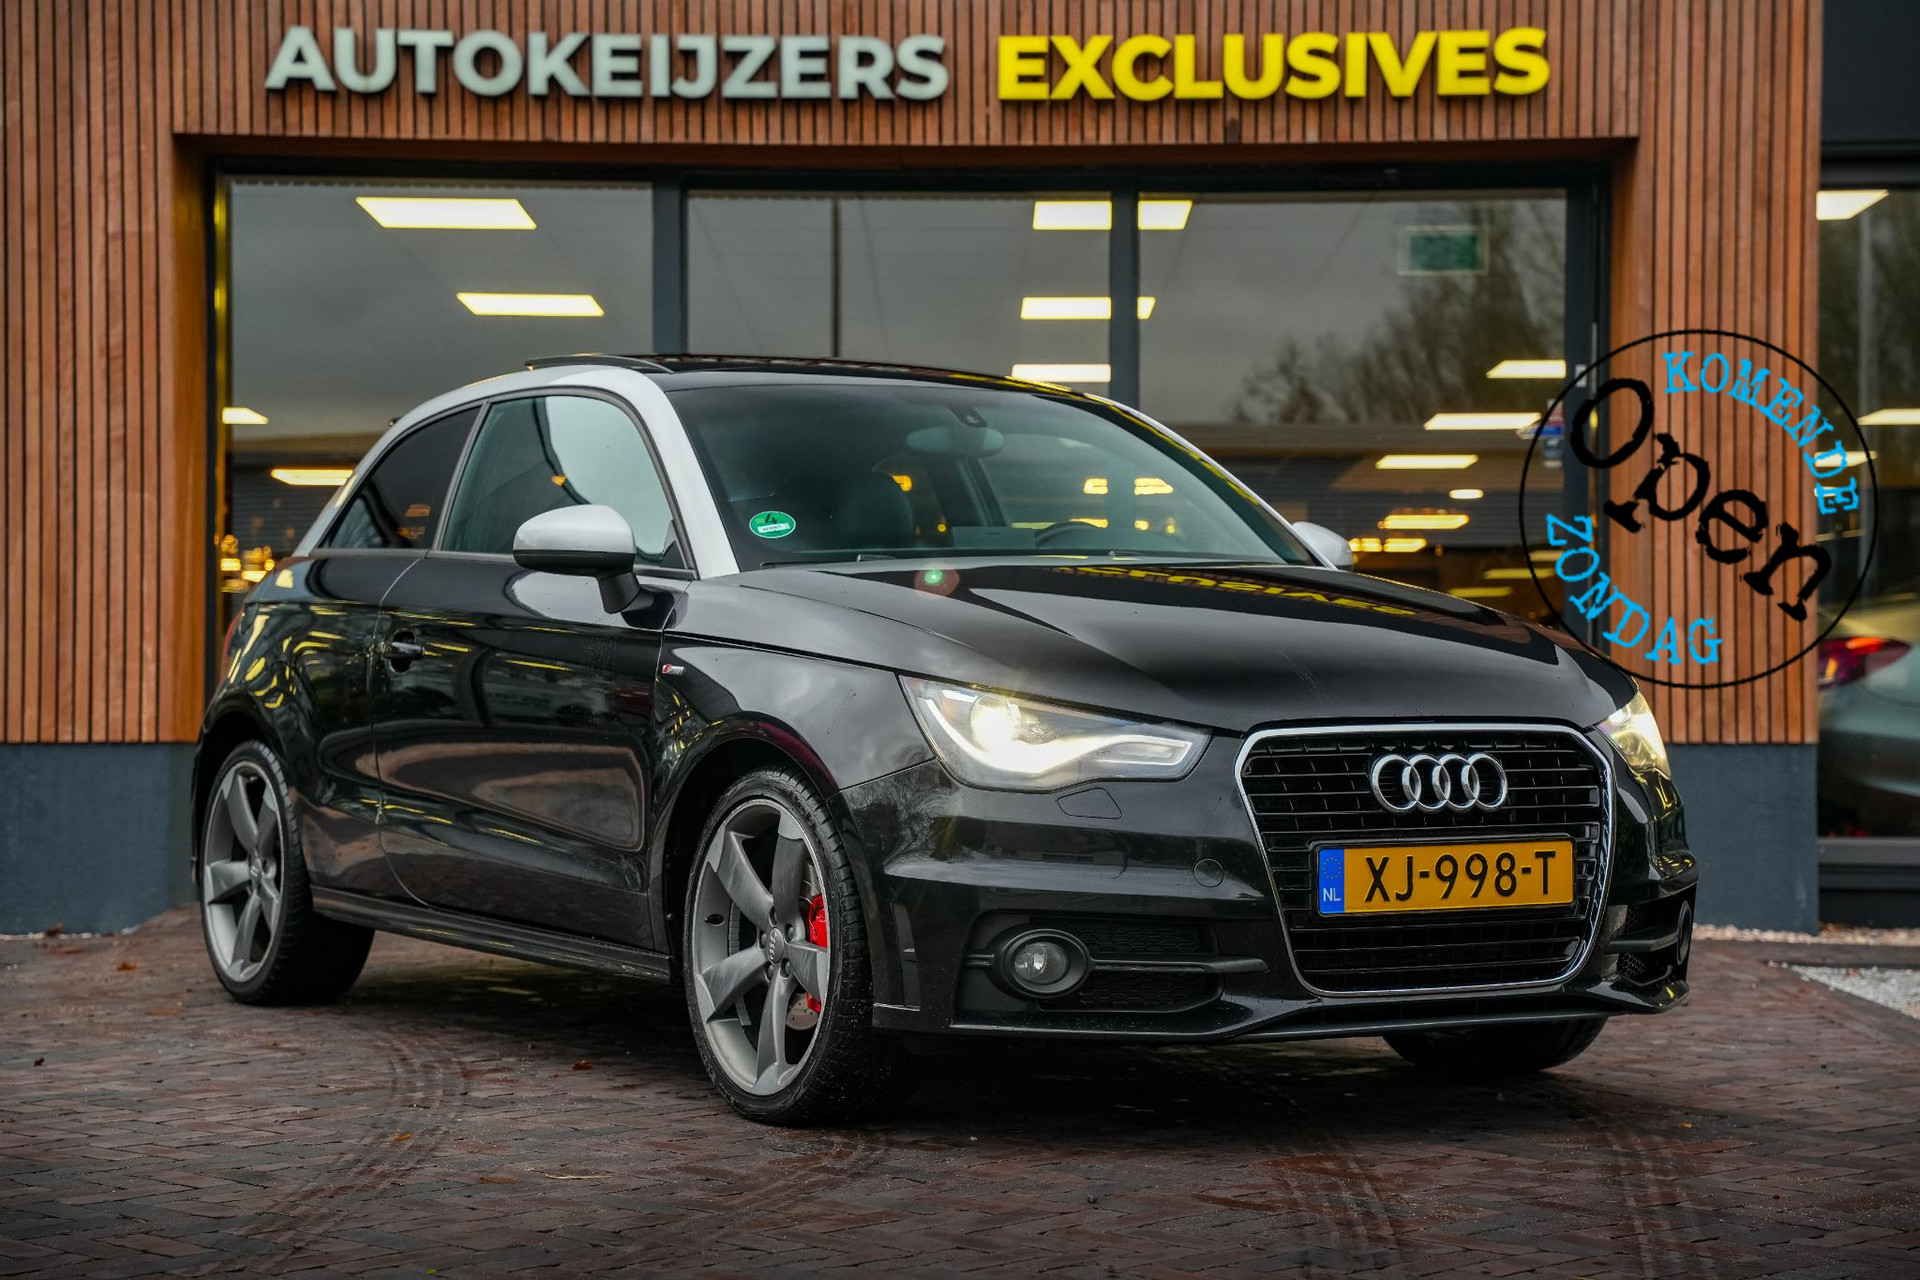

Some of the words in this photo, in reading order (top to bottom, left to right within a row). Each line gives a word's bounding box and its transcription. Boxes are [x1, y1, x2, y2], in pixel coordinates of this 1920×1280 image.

[265, 26, 949, 100] AUTOKEIJZERS
[998, 27, 1551, 100] EXCLUSIVES
[1323, 887, 1341, 902] NL
[1364, 850, 1556, 902] XJ-998-T
